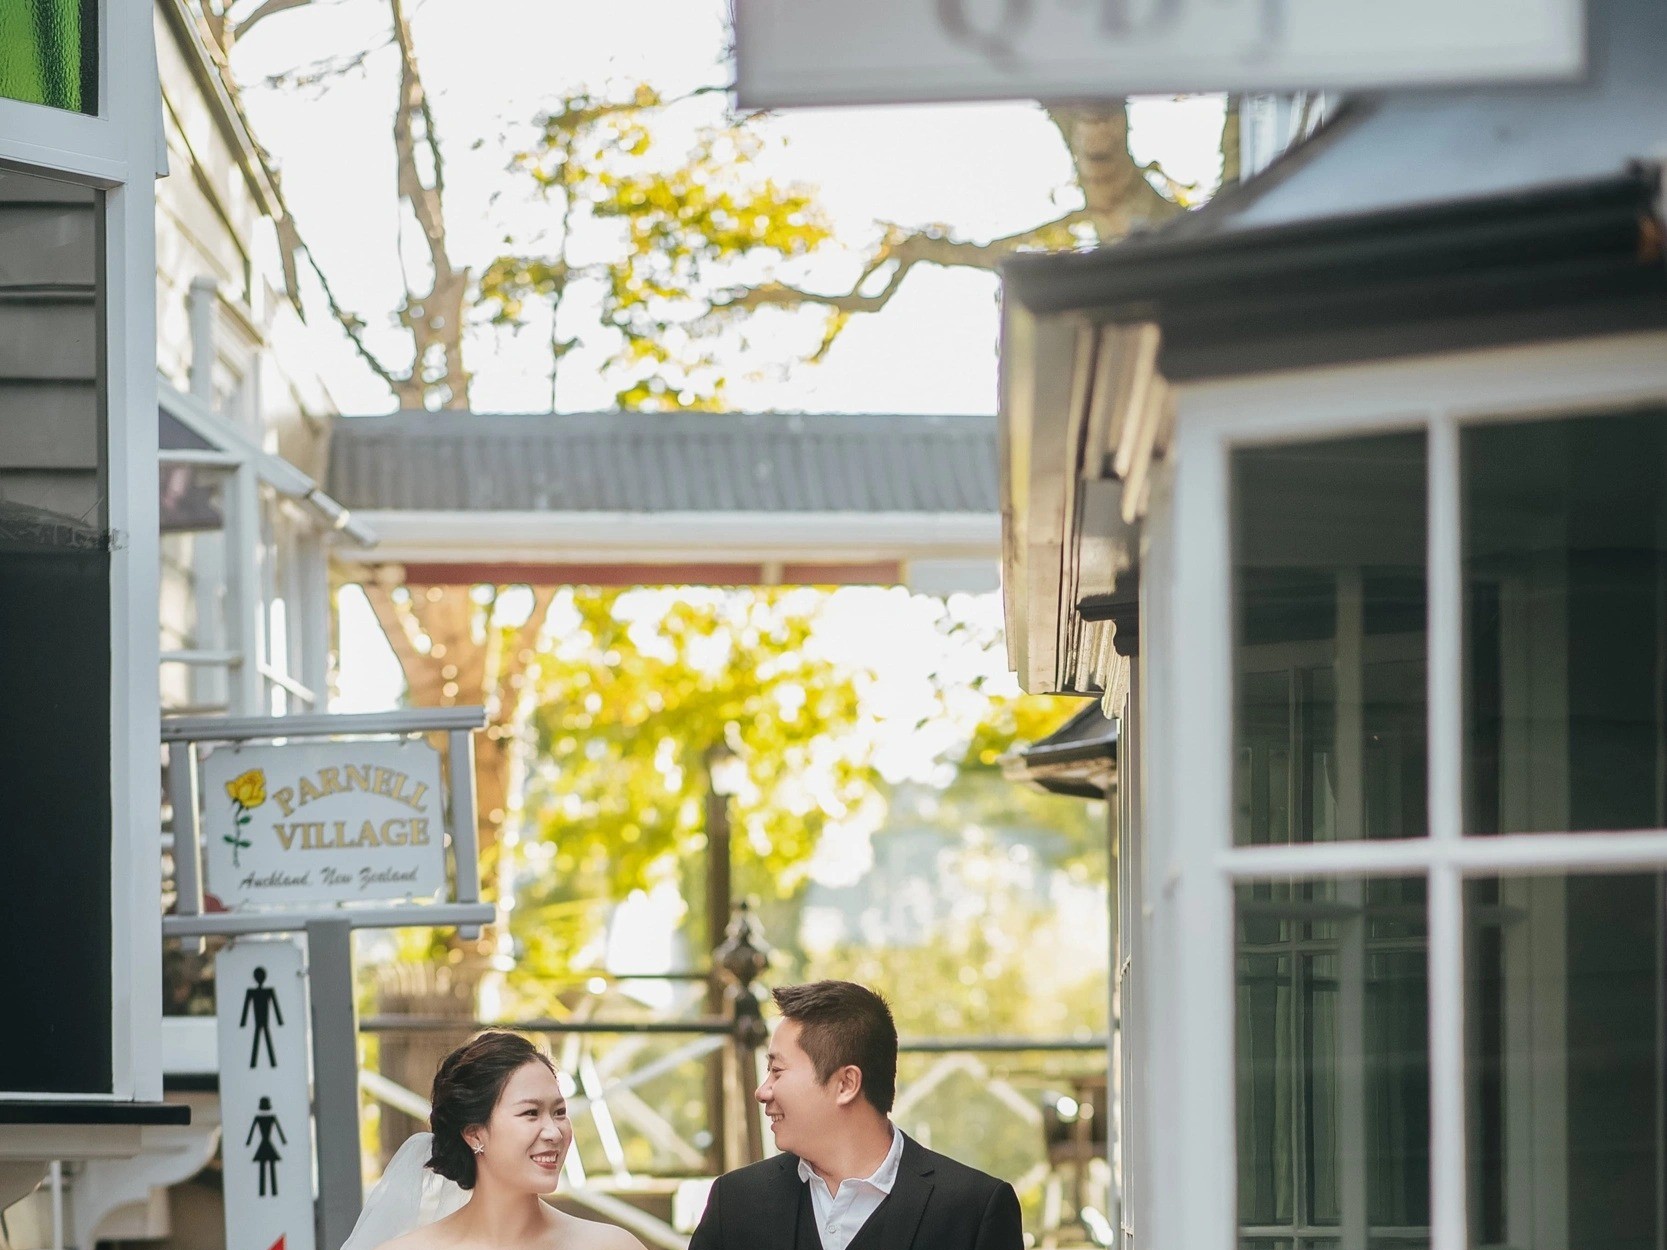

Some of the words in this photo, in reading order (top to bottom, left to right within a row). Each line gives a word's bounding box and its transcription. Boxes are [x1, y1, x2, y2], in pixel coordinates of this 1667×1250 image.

[272, 764, 428, 817] PARNELL
[272, 818, 430, 850] VILLAGE
[320, 866, 351, 886] New
[358, 865, 418, 889] Zealand
